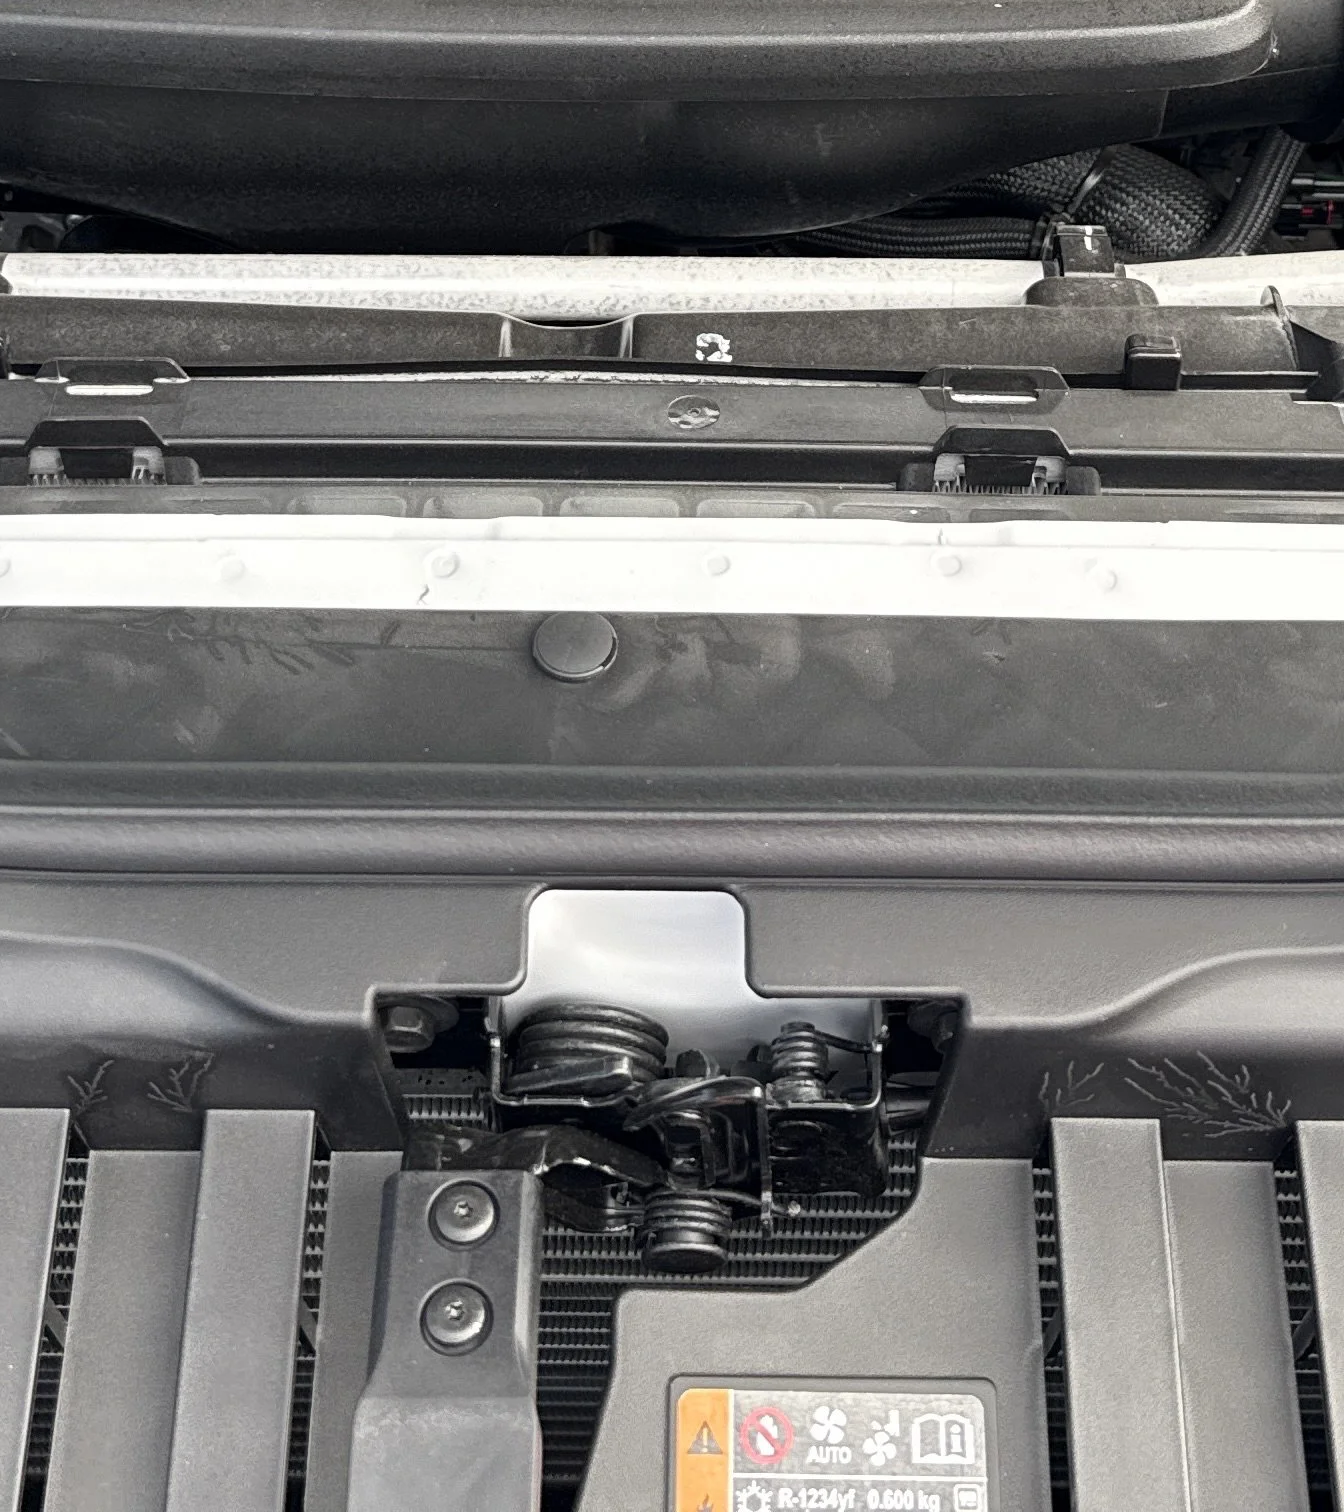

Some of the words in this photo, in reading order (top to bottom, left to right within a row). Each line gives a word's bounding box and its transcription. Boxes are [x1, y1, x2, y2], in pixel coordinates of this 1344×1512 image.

[807, 1445, 852, 1464] AUTO
[778, 1488, 856, 1512] R-1234yf
[866, 1489, 914, 1510] 0.600
[918, 1489, 940, 1512] kg
